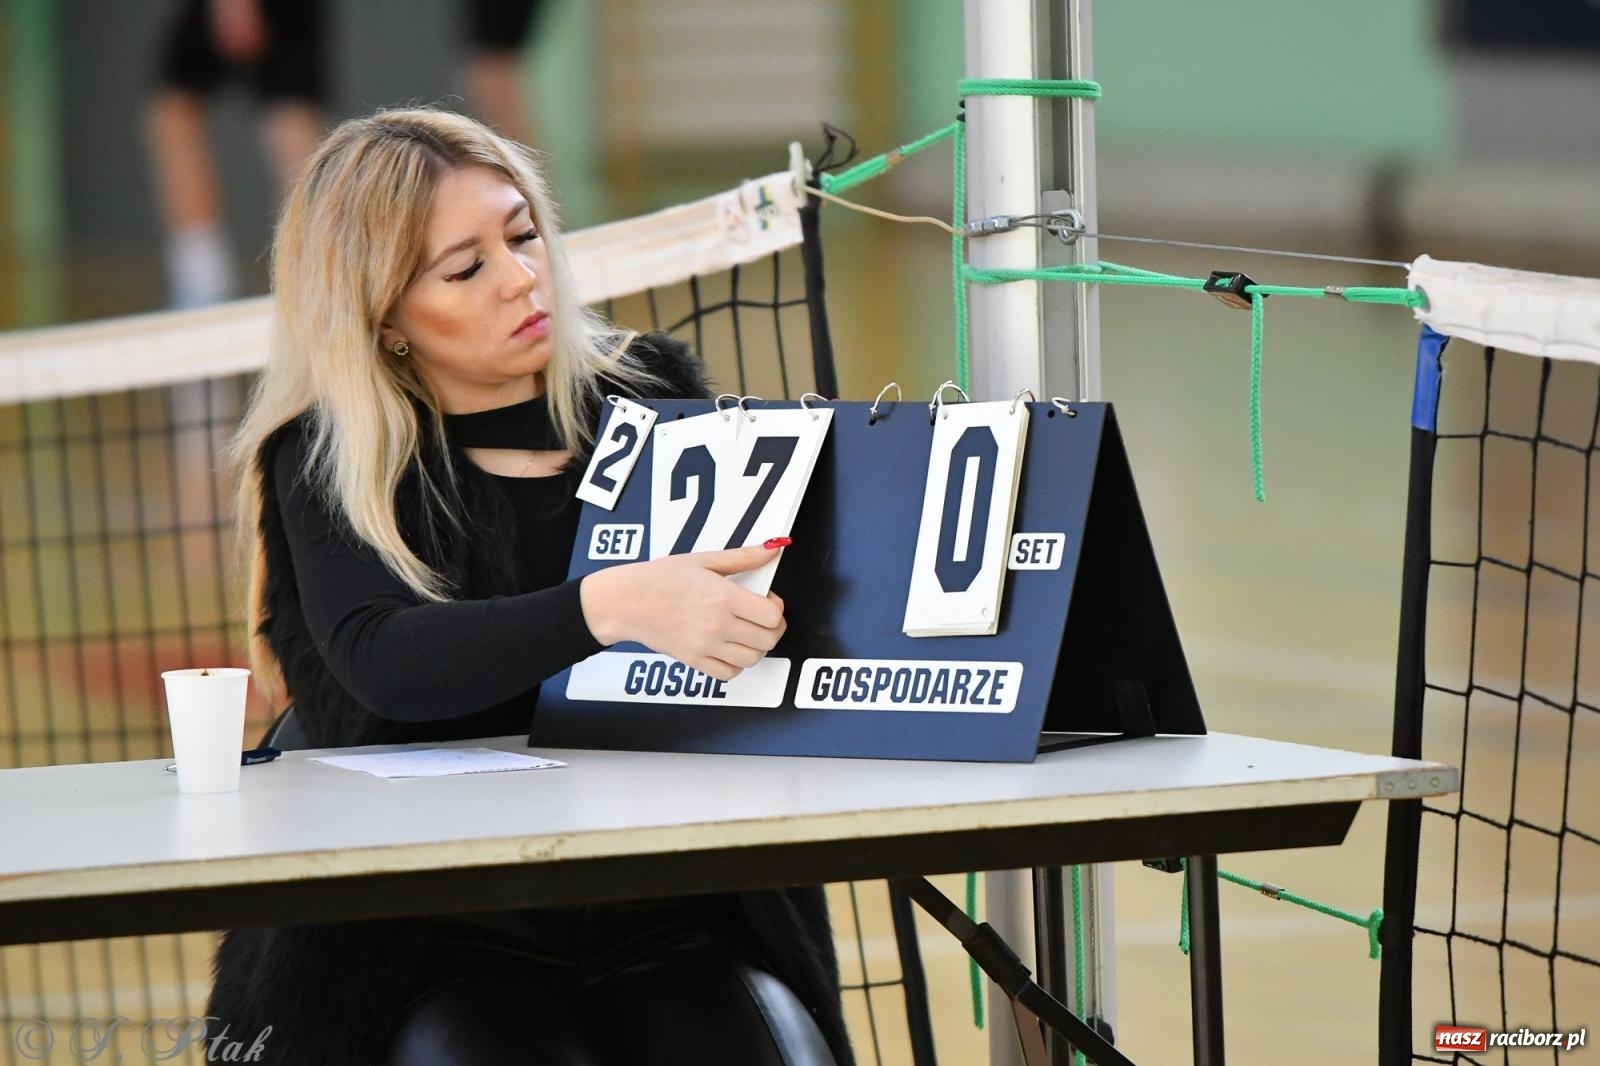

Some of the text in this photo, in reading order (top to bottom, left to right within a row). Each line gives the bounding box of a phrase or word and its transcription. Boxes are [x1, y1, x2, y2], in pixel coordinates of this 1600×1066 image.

[589, 422, 638, 493] 2
[669, 436, 800, 556] 27
[934, 426, 999, 593] 0
[595, 529, 638, 554] SET
[1015, 538, 1058, 564] SET
[810, 666, 1009, 705] GOSPODARZE
